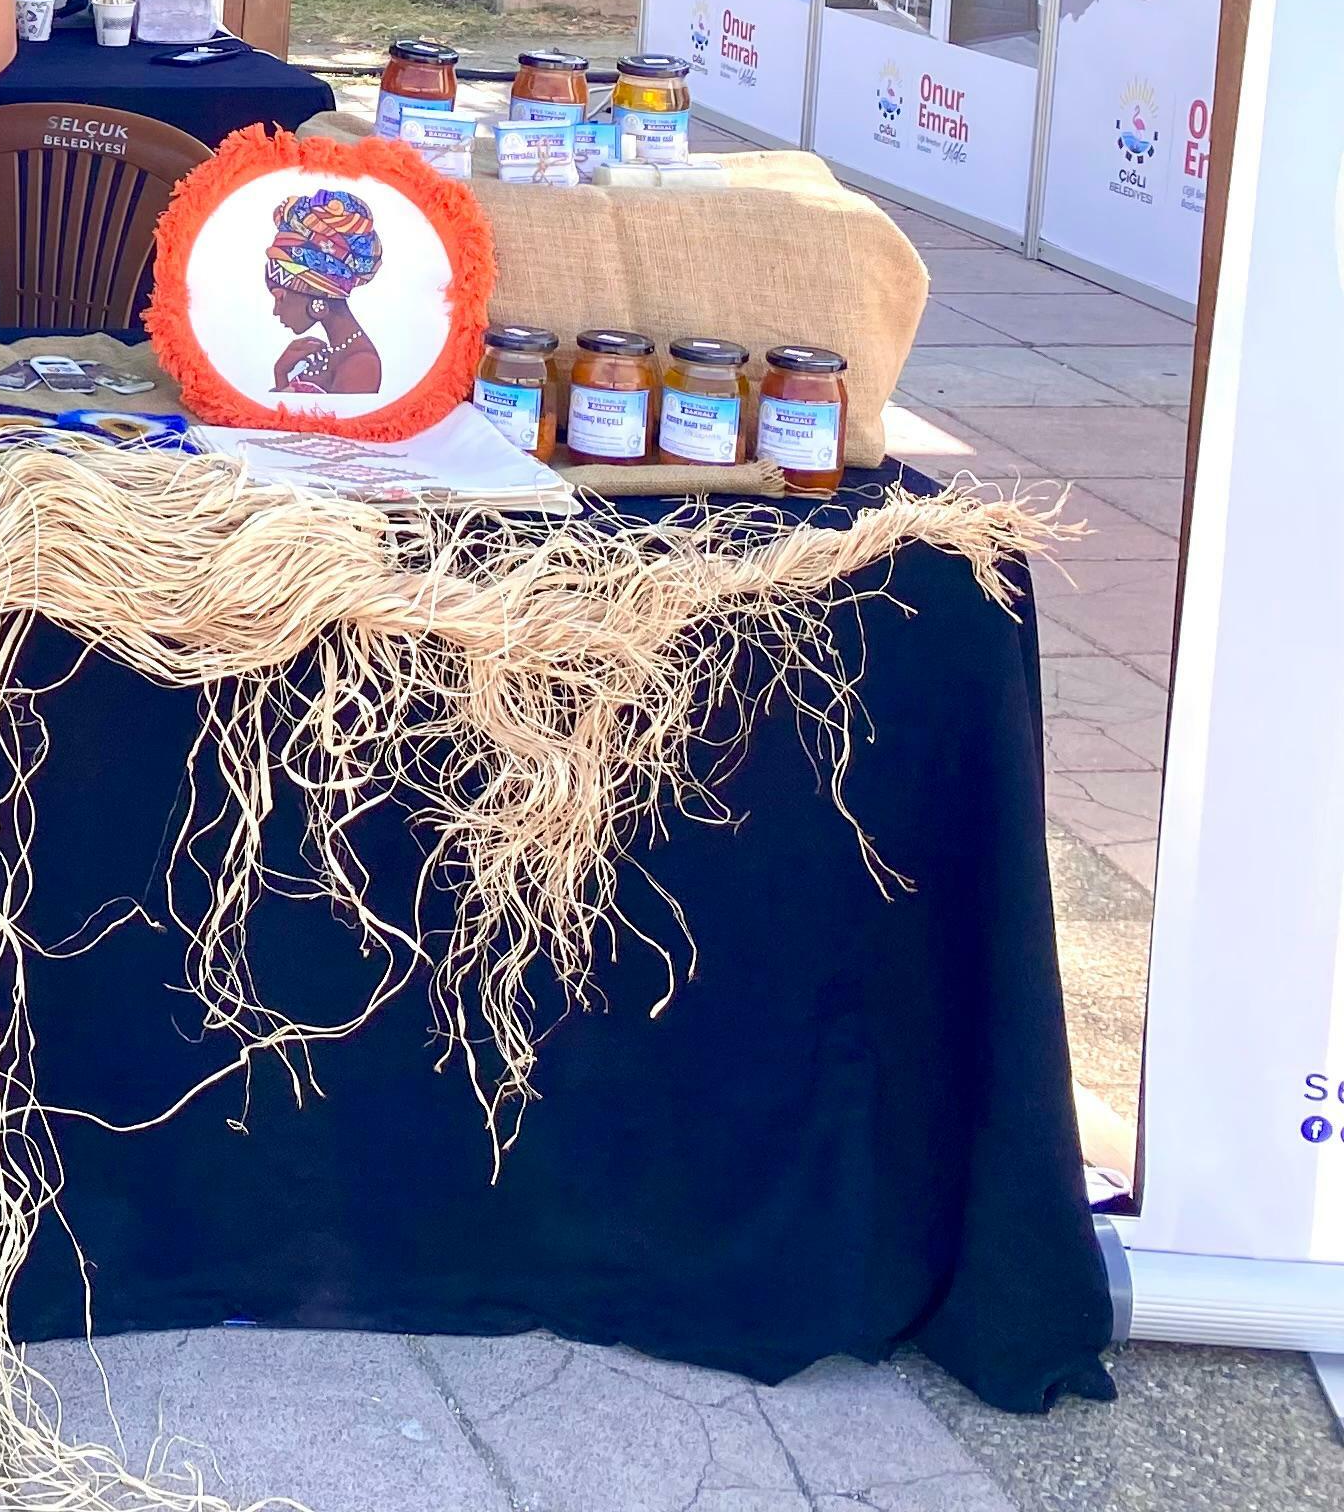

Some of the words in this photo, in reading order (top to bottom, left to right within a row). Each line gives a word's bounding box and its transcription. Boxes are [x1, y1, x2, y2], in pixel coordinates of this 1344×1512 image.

[722, 9, 756, 42] Onur
[720, 35, 758, 69] Emrah
[920, 74, 965, 113] Onur
[47, 115, 130, 140] SELÇUK
[428, 131, 459, 140] BAKKALI
[918, 103, 969, 143] Emrah
[43, 134, 127, 156] BELEDİYESİ
